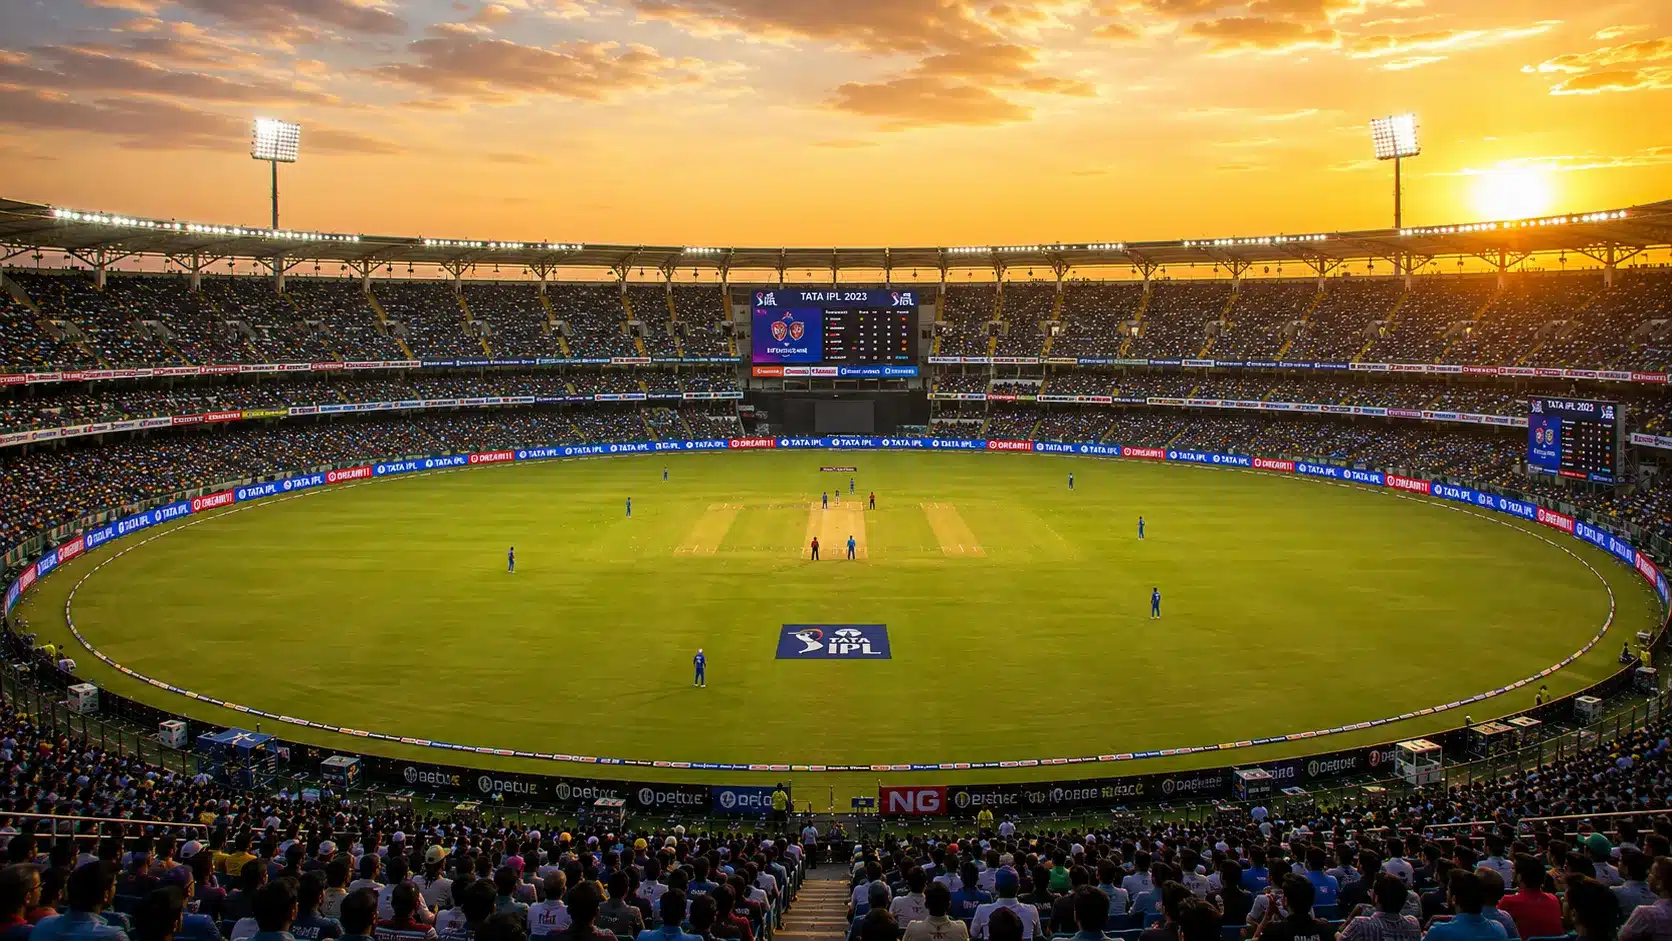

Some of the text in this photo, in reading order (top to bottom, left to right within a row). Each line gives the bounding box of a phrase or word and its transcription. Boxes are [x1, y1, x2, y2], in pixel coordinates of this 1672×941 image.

[801, 292, 868, 301] TATA IPL 2023
[1548, 400, 1564, 410] TATA
[911, 439, 923, 447] IPL
[573, 447, 591, 455] TATA
[1044, 444, 1062, 452] TATA
[528, 450, 545, 458] TATA
[1179, 452, 1196, 460] TATA
[435, 458, 451, 466] TATA
[386, 464, 404, 473] TATA
[1308, 465, 1324, 474] TATA
[1352, 471, 1369, 481] TATA
[292, 478, 310, 488] TATA
[247, 487, 264, 497] TATA
[1444, 487, 1460, 498] TATA
[828, 643, 881, 654] IPL
[889, 790, 940, 812] NG
